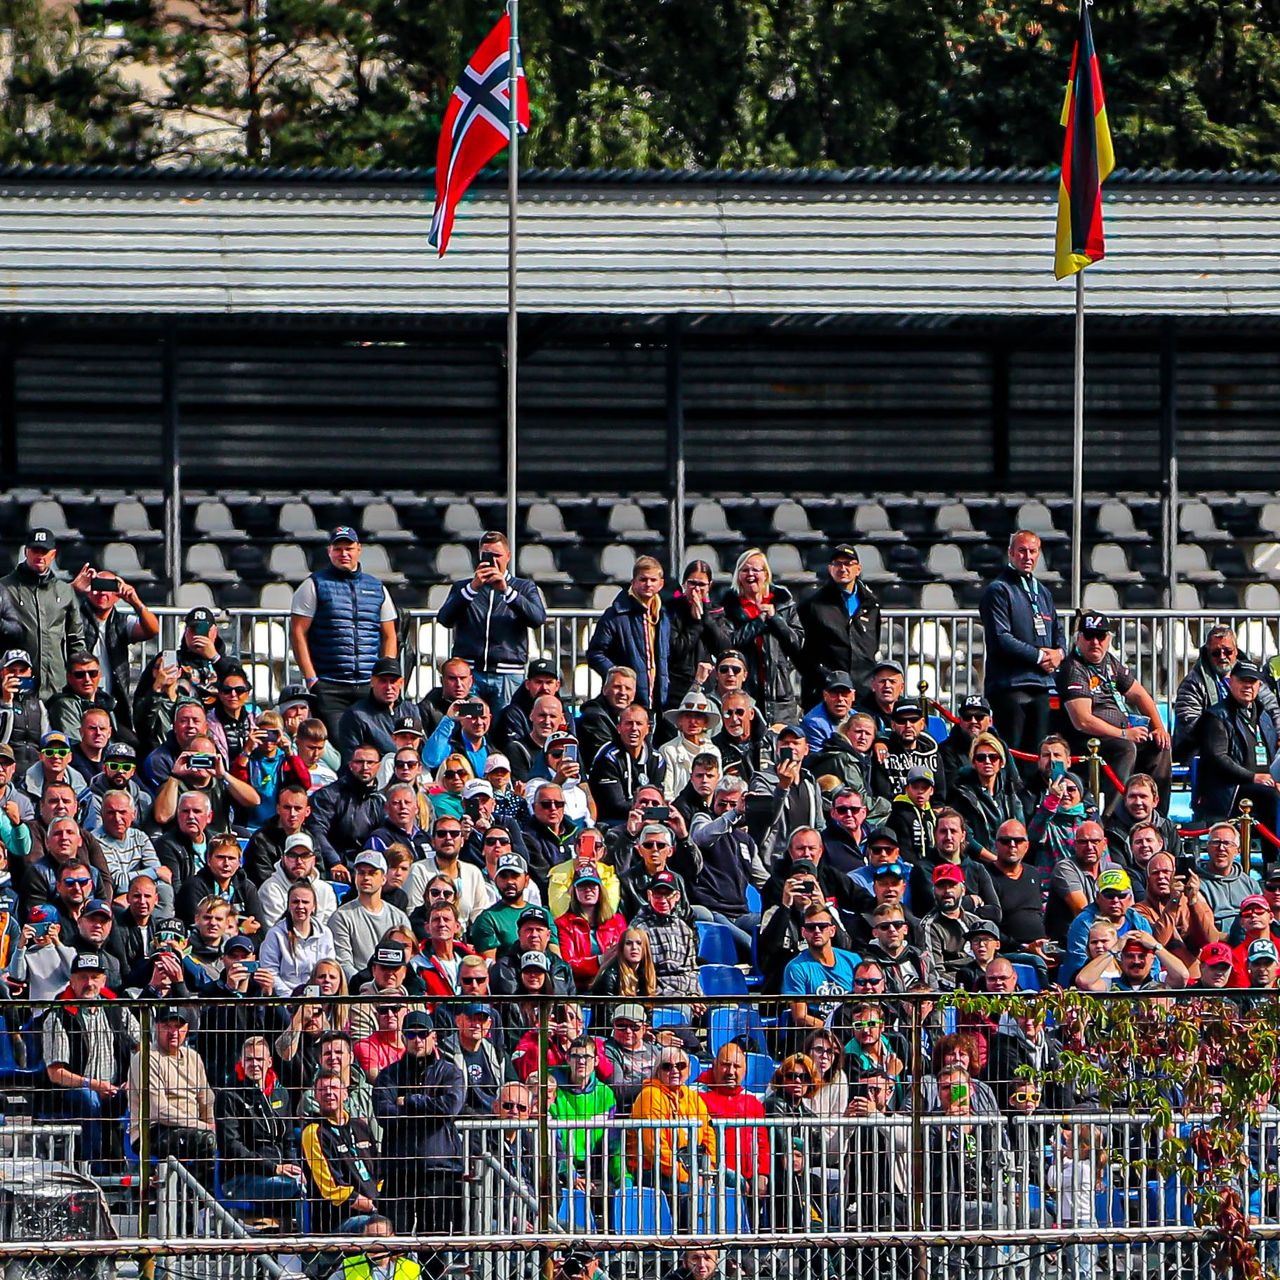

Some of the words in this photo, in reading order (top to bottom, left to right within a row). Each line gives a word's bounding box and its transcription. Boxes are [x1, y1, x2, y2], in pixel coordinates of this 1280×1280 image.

[966, 696, 981, 706] RX
[499, 855, 518, 866] RX
[1254, 940, 1273, 951] RX
[525, 954, 541, 962] RX
